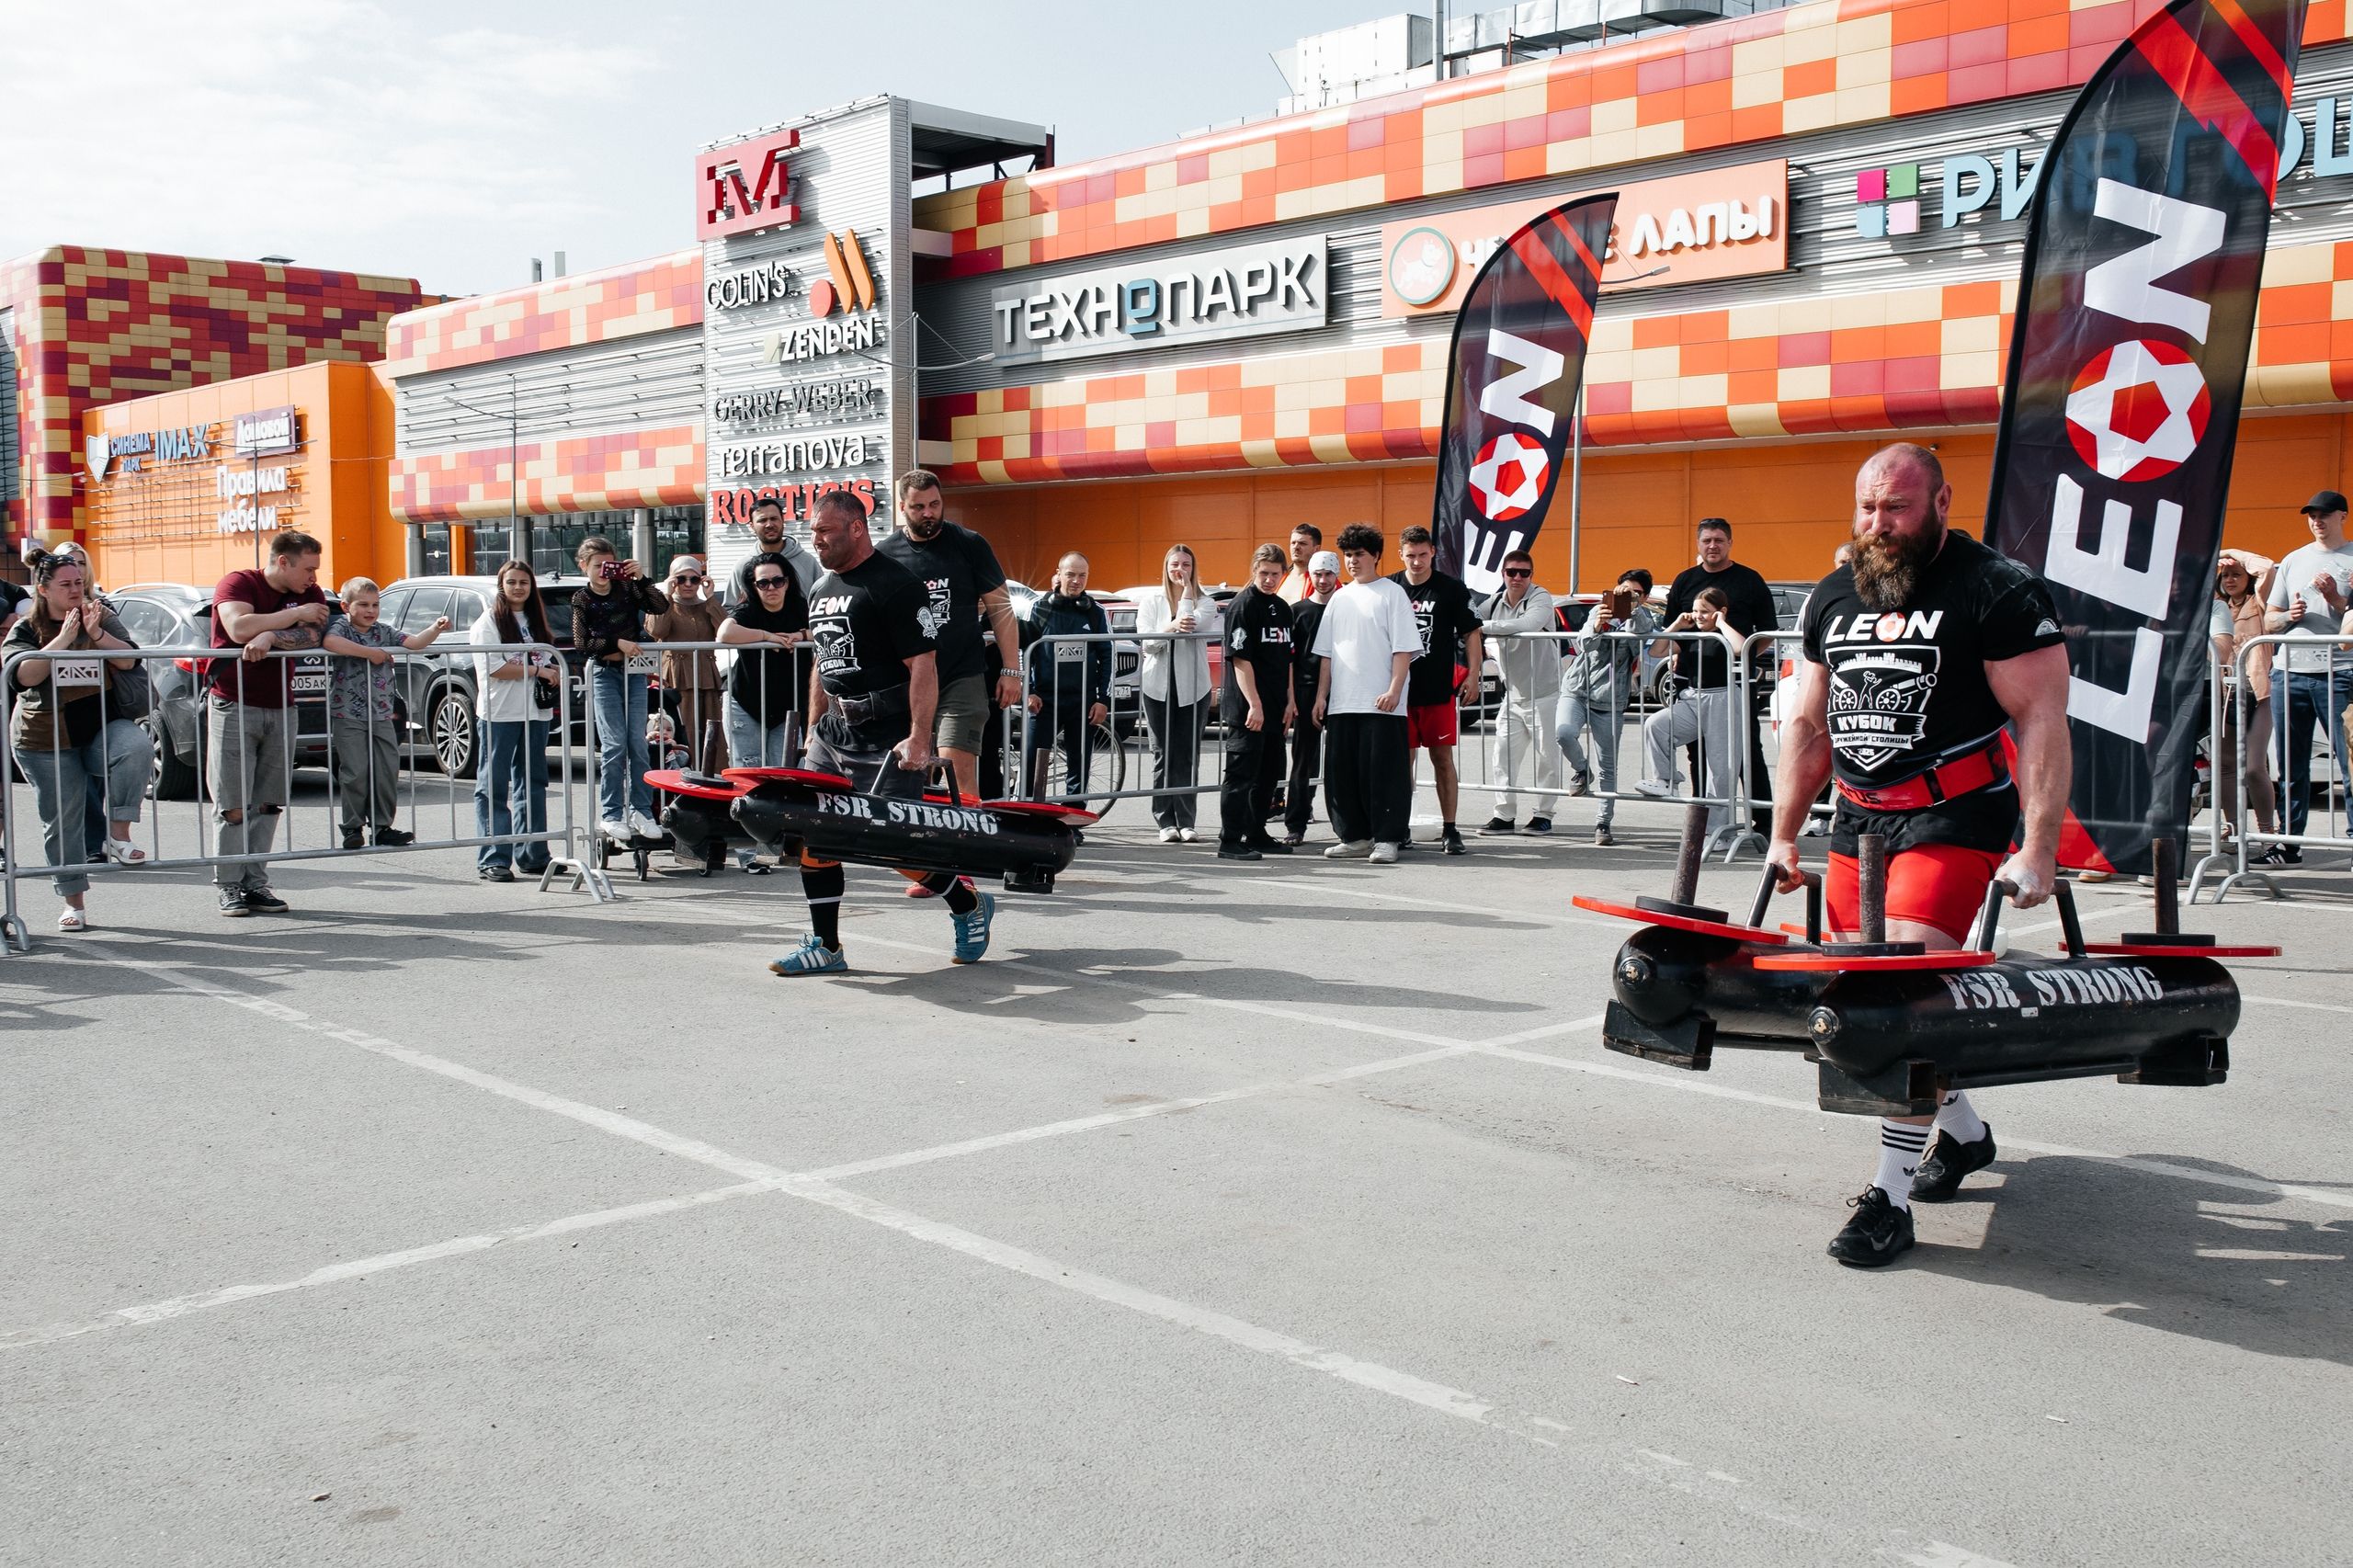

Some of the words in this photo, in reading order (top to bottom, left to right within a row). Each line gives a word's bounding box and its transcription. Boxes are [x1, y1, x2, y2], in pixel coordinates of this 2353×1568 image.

[1629, 195, 1774, 256] ЛАПЫ
[706, 262, 789, 309] COLIN'S
[995, 253, 1314, 344] ТЕХНОПАРК
[781, 318, 876, 361] ZENDEN
[714, 390, 782, 422] GERRY
[791, 378, 871, 413] WEBER
[110, 432, 152, 457] СИНЕМА
[154, 424, 210, 460] IMAX
[123, 459, 142, 472] ПАРК
[1463, 328, 1564, 596] EON
[2045, 177, 2227, 744] LEON
[217, 465, 289, 502] Правила
[217, 498, 278, 533] мебели
[809, 596, 853, 616] LEON
[1261, 627, 1291, 643] LEON
[1825, 610, 1944, 644] LEON
[1837, 714, 1897, 733] КУБОК
